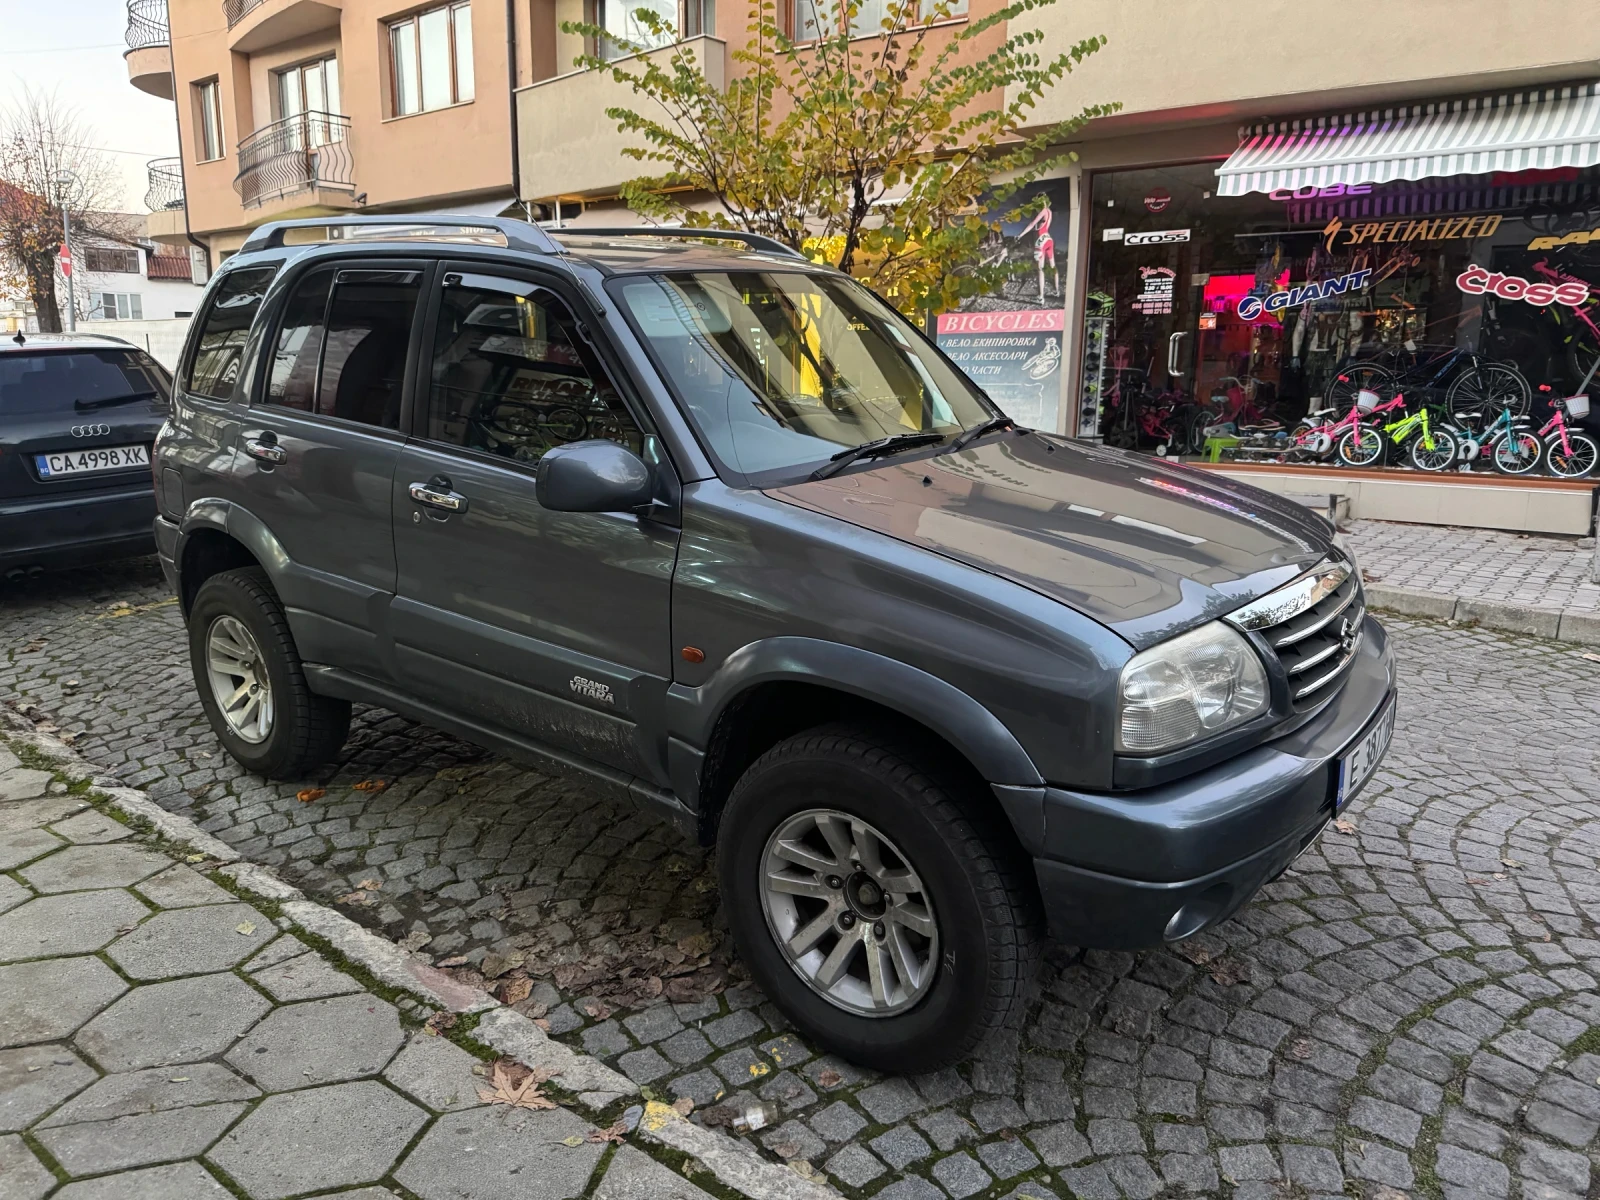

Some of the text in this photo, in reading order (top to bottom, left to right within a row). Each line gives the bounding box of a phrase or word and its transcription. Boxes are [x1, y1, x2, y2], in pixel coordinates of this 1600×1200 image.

[1343, 215, 1502, 245] SPECIALIZED
[1263, 268, 1372, 312] GIANT
[944, 312, 1058, 332] BICYCLES
[945, 337, 1038, 348] ВЕЛО ЕКИПИРОВКА
[972, 351, 1029, 361] АКСЕСОАРИ
[971, 366, 1002, 375] ЧАСТИ
[78, 450, 120, 469] 4998
[570, 680, 615, 704] VITARA
[574, 676, 609, 692] GRAND
